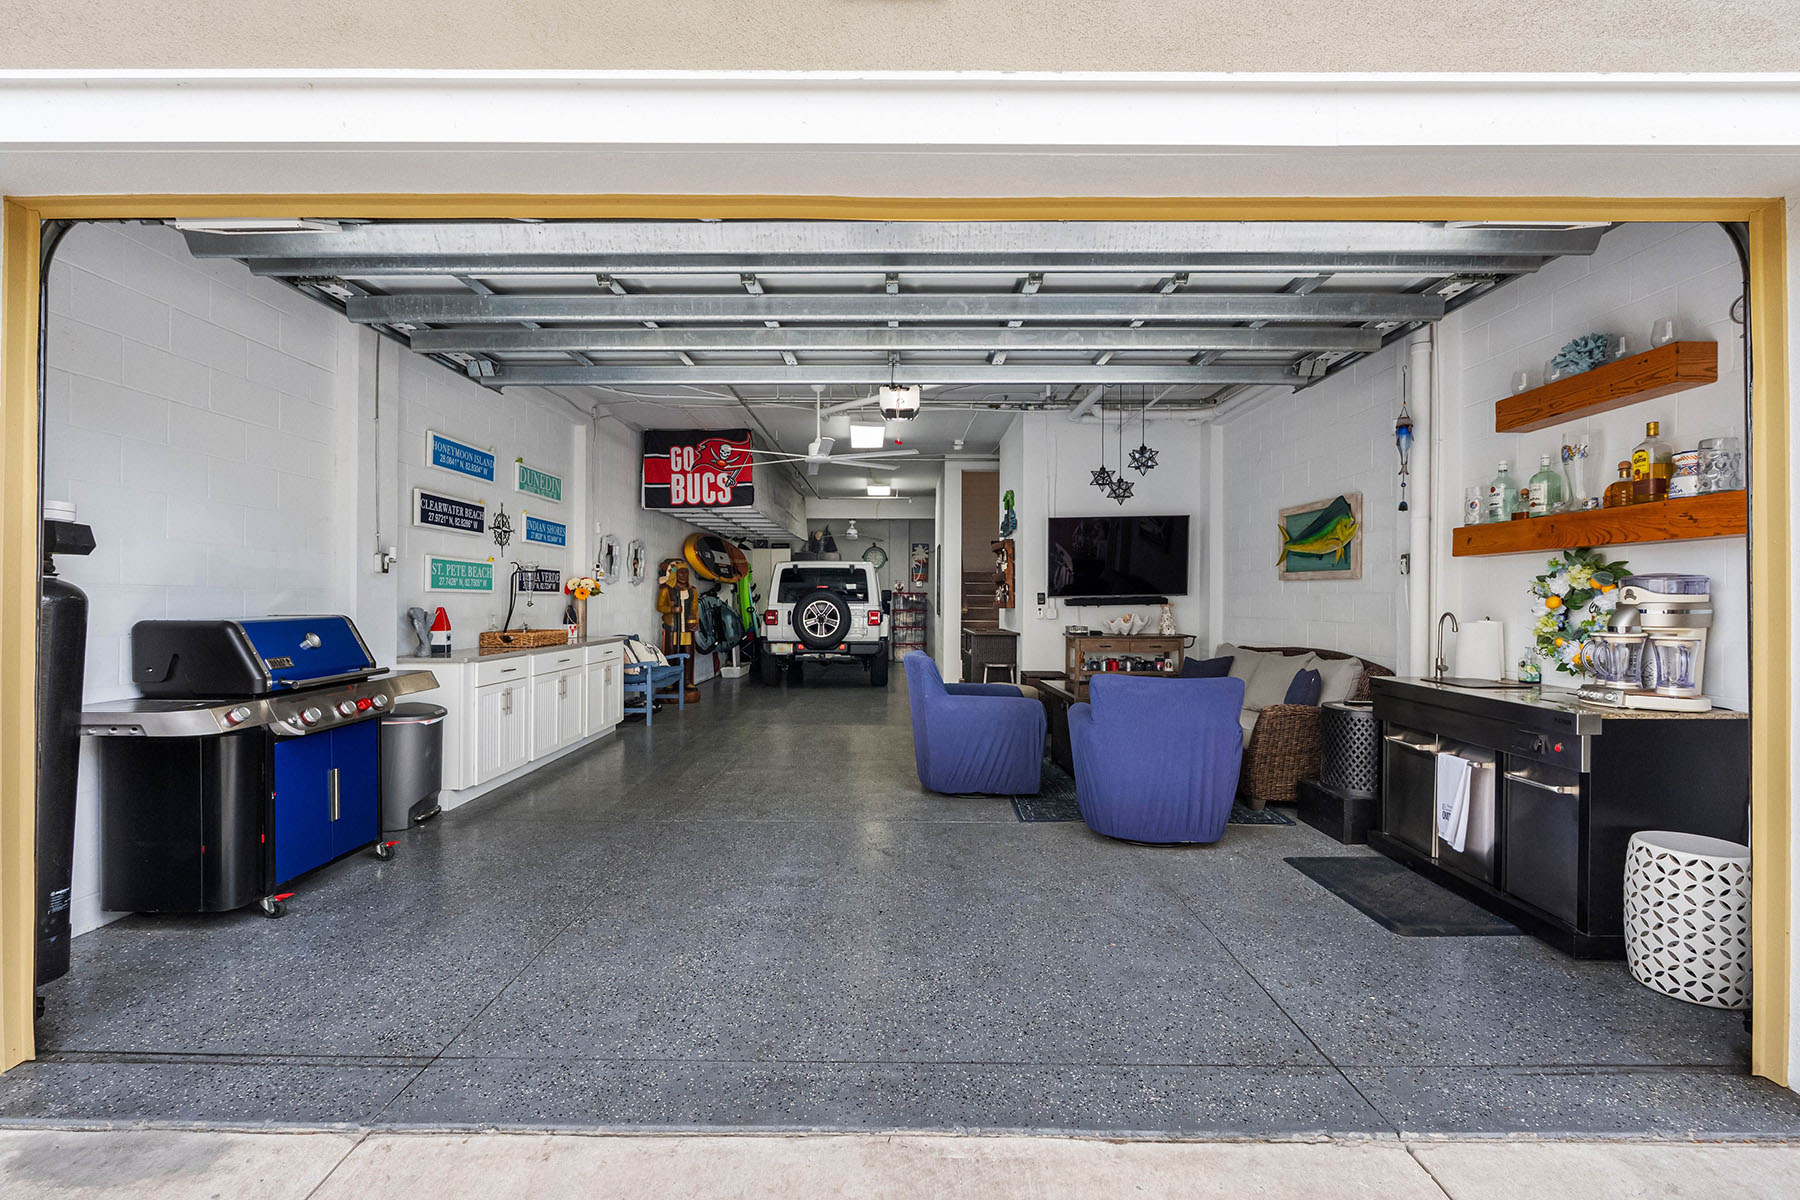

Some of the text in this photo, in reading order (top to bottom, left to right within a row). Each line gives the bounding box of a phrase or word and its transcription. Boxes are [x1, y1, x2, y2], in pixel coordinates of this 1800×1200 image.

[433, 440, 495, 469] HONEYMOON ISLAND
[670, 446, 694, 472] GO
[519, 467, 561, 493] DUNEDIN
[670, 472, 732, 504] BUCS
[421, 498, 485, 521] CLEARWATER BEACH
[526, 519, 547, 534] INDIAN
[546, 523, 566, 537] SHORES
[431, 562, 493, 579] ST. PETE BEACH
[541, 571, 560, 583] VERDE
